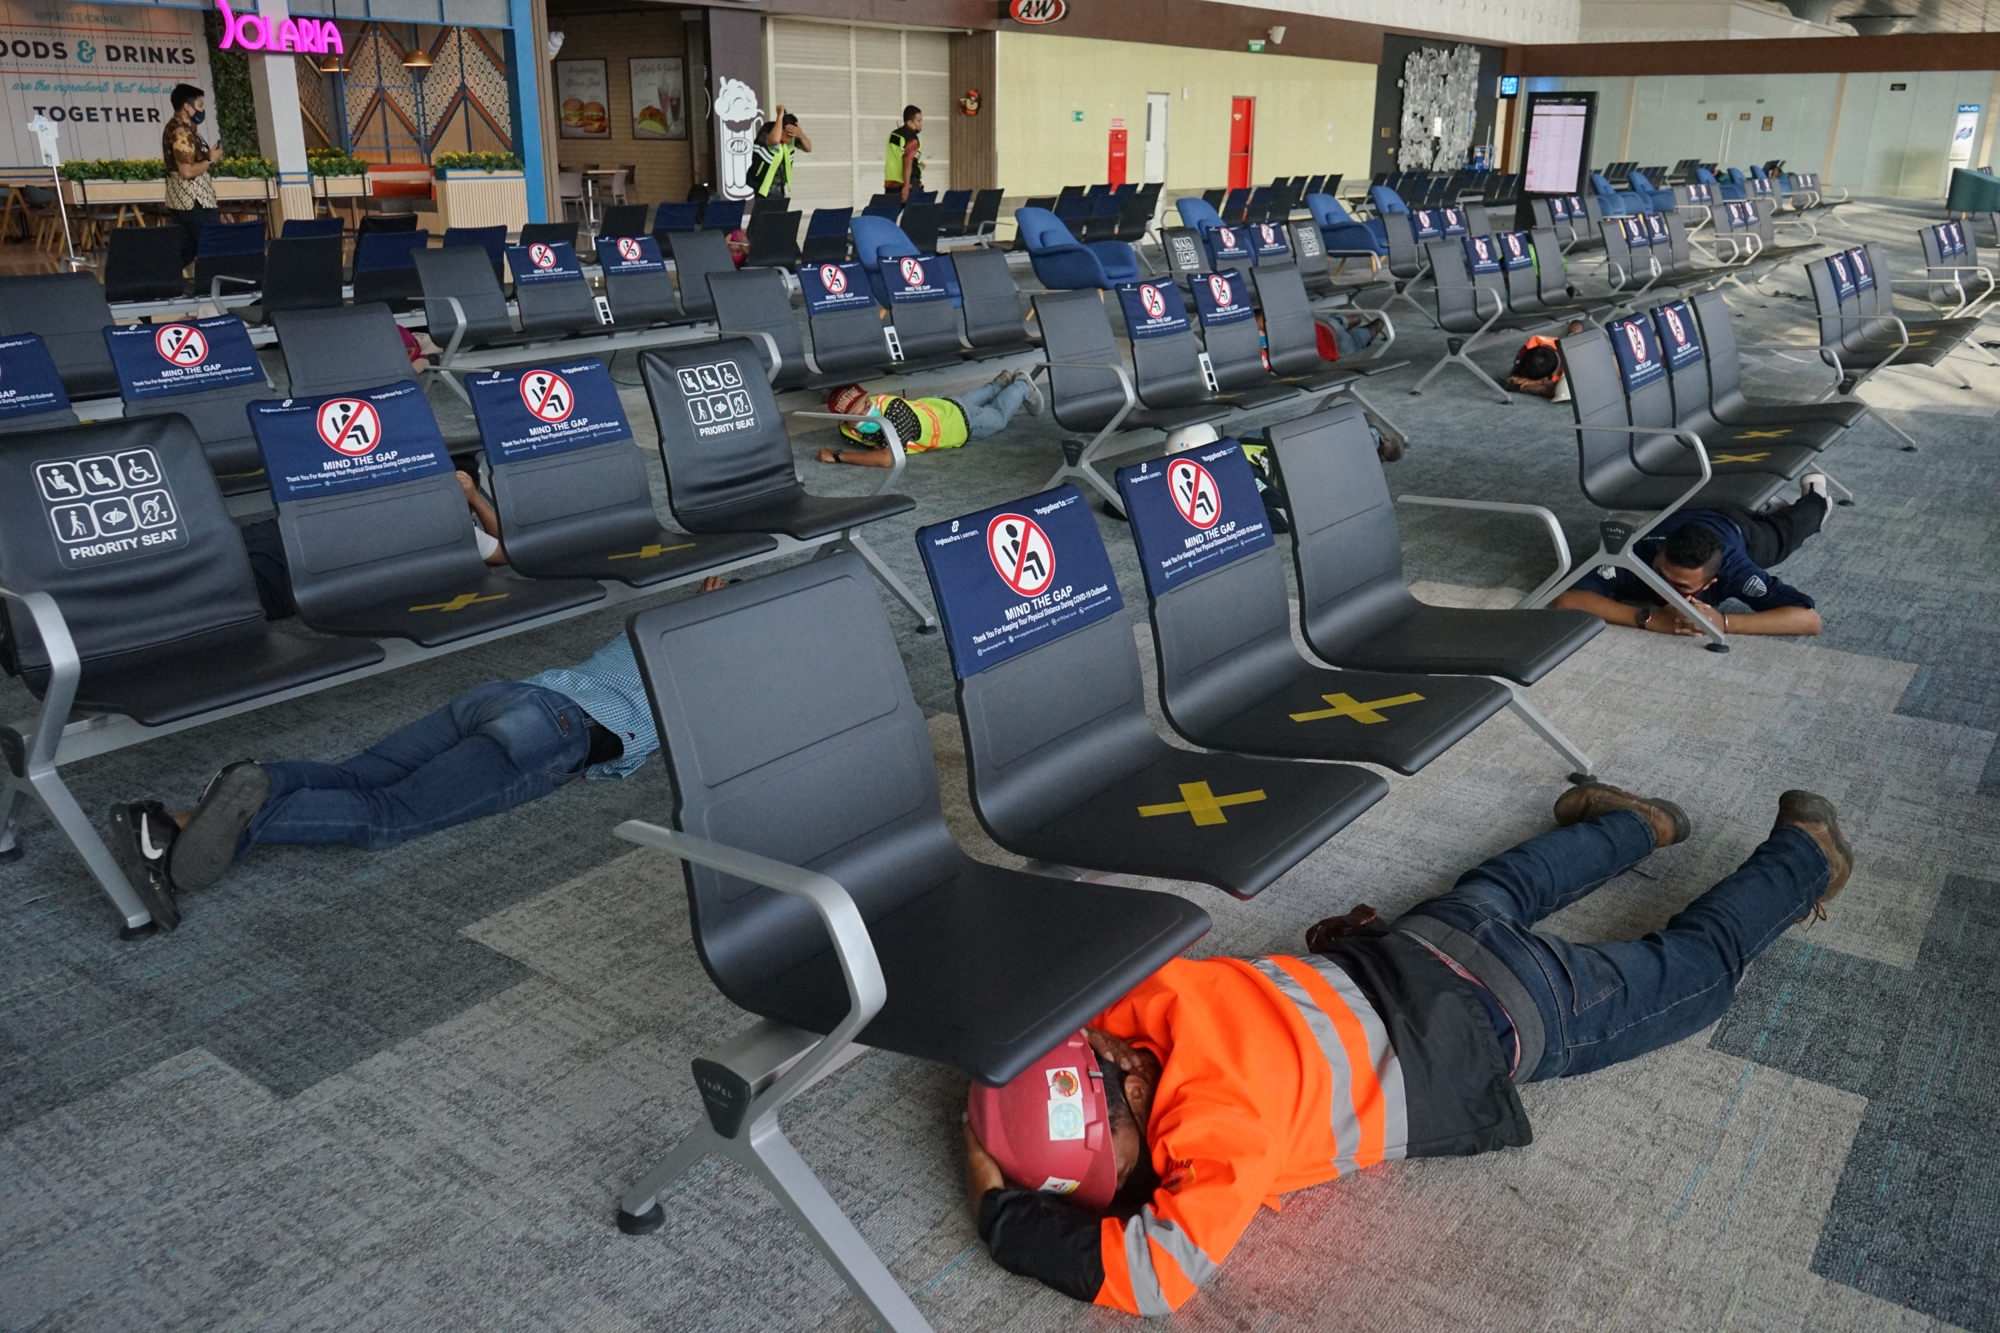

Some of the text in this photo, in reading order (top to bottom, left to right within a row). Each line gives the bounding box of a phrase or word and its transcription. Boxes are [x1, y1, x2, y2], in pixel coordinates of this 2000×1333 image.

[77, 40, 97, 64] &
[106, 45, 196, 65] DRINKS
[12, 82, 32, 91] are
[35, 80, 51, 92] the
[54, 81, 109, 96] ingredients
[113, 81, 135, 93] that
[138, 83, 160, 94] bind
[33, 106, 161, 123] TOGETHER
[161, 364, 222, 378] MIND THE GAP
[0, 390, 17, 399] AP
[529, 418, 589, 436] MIND THE GAP
[700, 418, 755, 437] PRIORITY SEAT
[323, 451, 398, 471] MIND THE GAP
[286, 475, 301, 483] Thank
[317, 470, 337, 479] Keeping
[346, 466, 366, 475] Physical
[365, 463, 384, 471] Distance
[1034, 500, 1067, 515] Yogyakarta
[70, 529, 178, 560] PRIORITY SEAT
[1184, 535, 1204, 549] MIND
[1204, 528, 1220, 541] THE
[1220, 521, 1236, 535] GAP
[1005, 585, 1073, 621] MIND THE GAP
[973, 633, 987, 645] Thank
[986, 631, 995, 639] You
[994, 628, 1002, 636] For
[1002, 621, 1019, 633] Keeping
[1018, 617, 1028, 626] Your
[1028, 611, 1044, 623] Physical
[1044, 605, 1061, 617] Distance
[1060, 600, 1075, 610] During
[1073, 592, 1091, 604] COVID-19
[1091, 584, 1109, 597] Outbreak
[702, 1077, 733, 1099] TRAVEL
